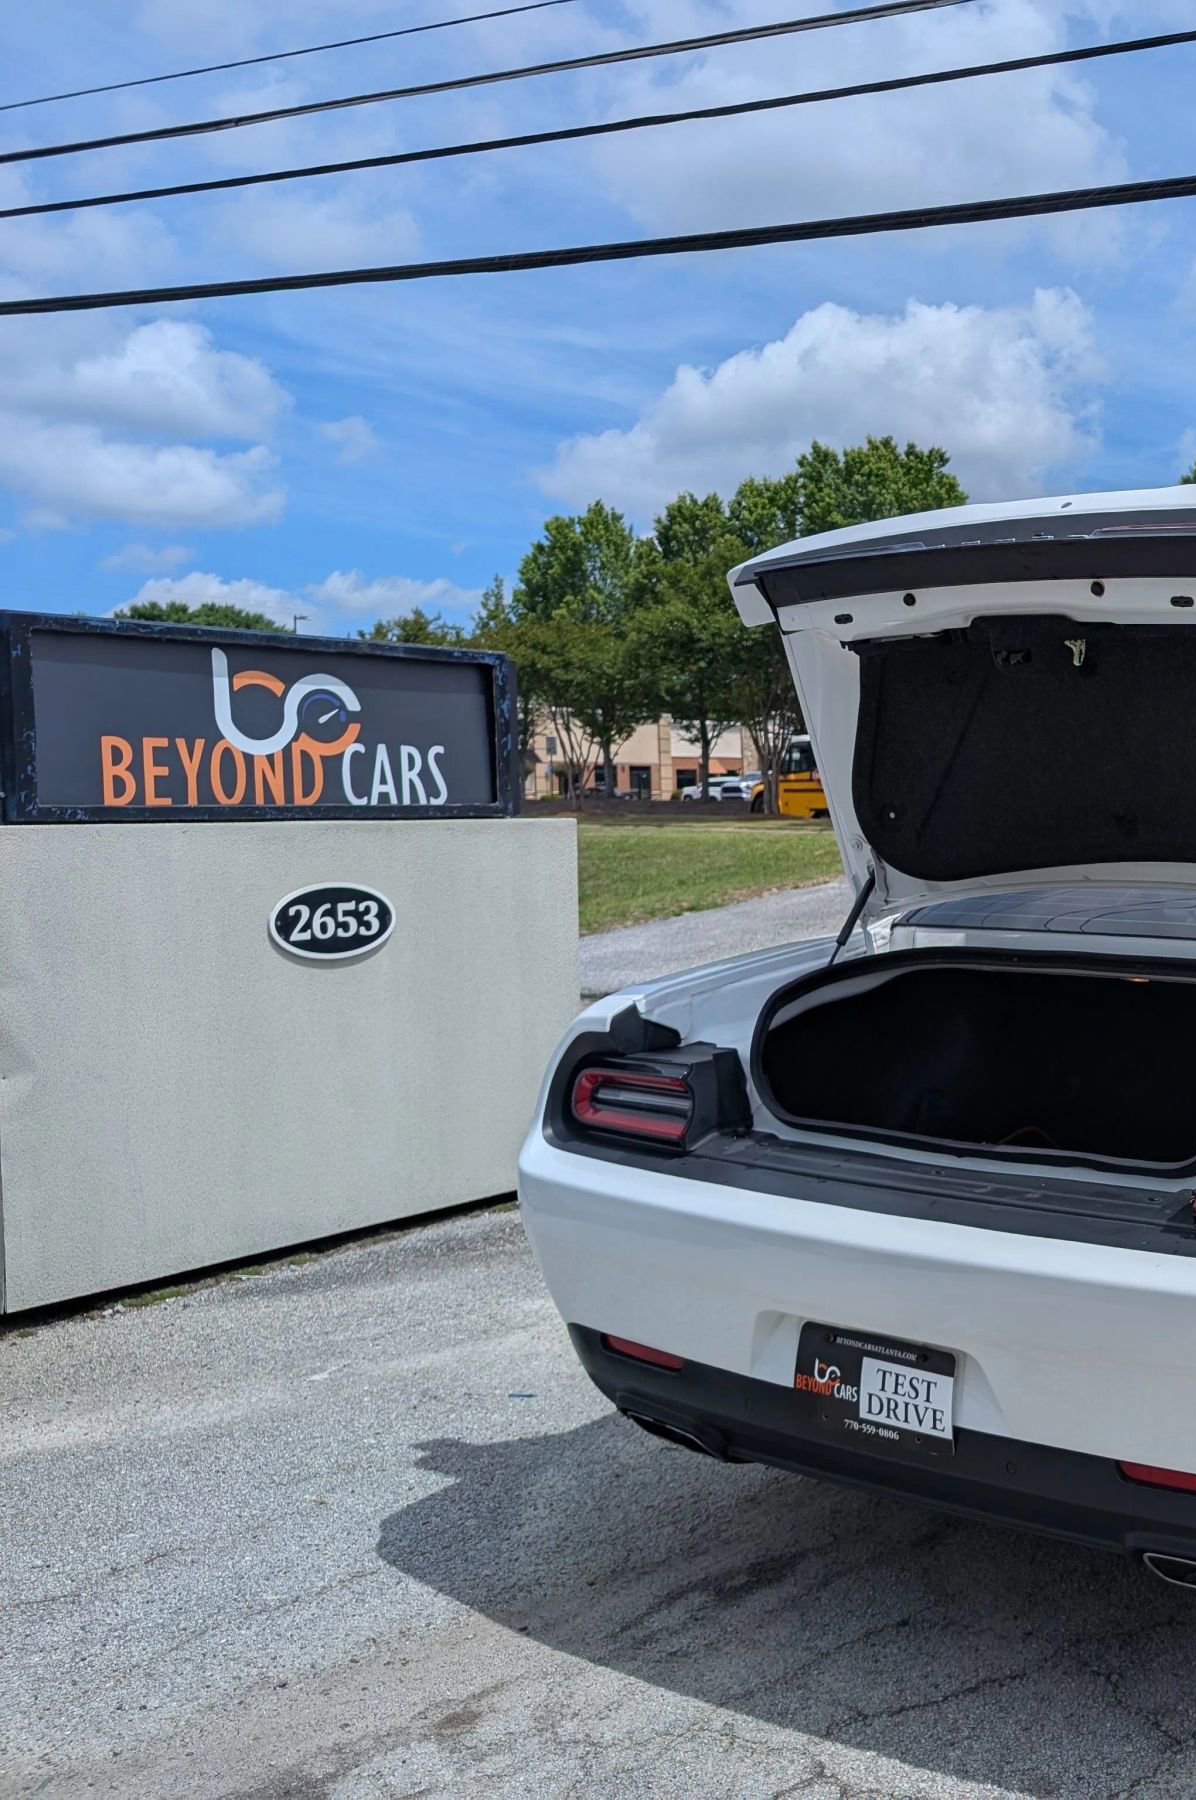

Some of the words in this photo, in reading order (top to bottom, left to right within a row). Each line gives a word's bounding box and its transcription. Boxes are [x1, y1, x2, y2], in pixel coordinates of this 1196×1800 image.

[101, 735, 324, 807] BEYOND
[342, 743, 448, 806] CARS
[288, 900, 380, 942] 2653
[836, 1336, 918, 1361] BEYONDCARSATLANTA.COM
[796, 1373, 833, 1396] BEYOND
[833, 1382, 858, 1402] CARS
[876, 1367, 937, 1404] TEST
[843, 1418, 900, 1441] 770-559-0806
[866, 1392, 946, 1433] DRIVE
